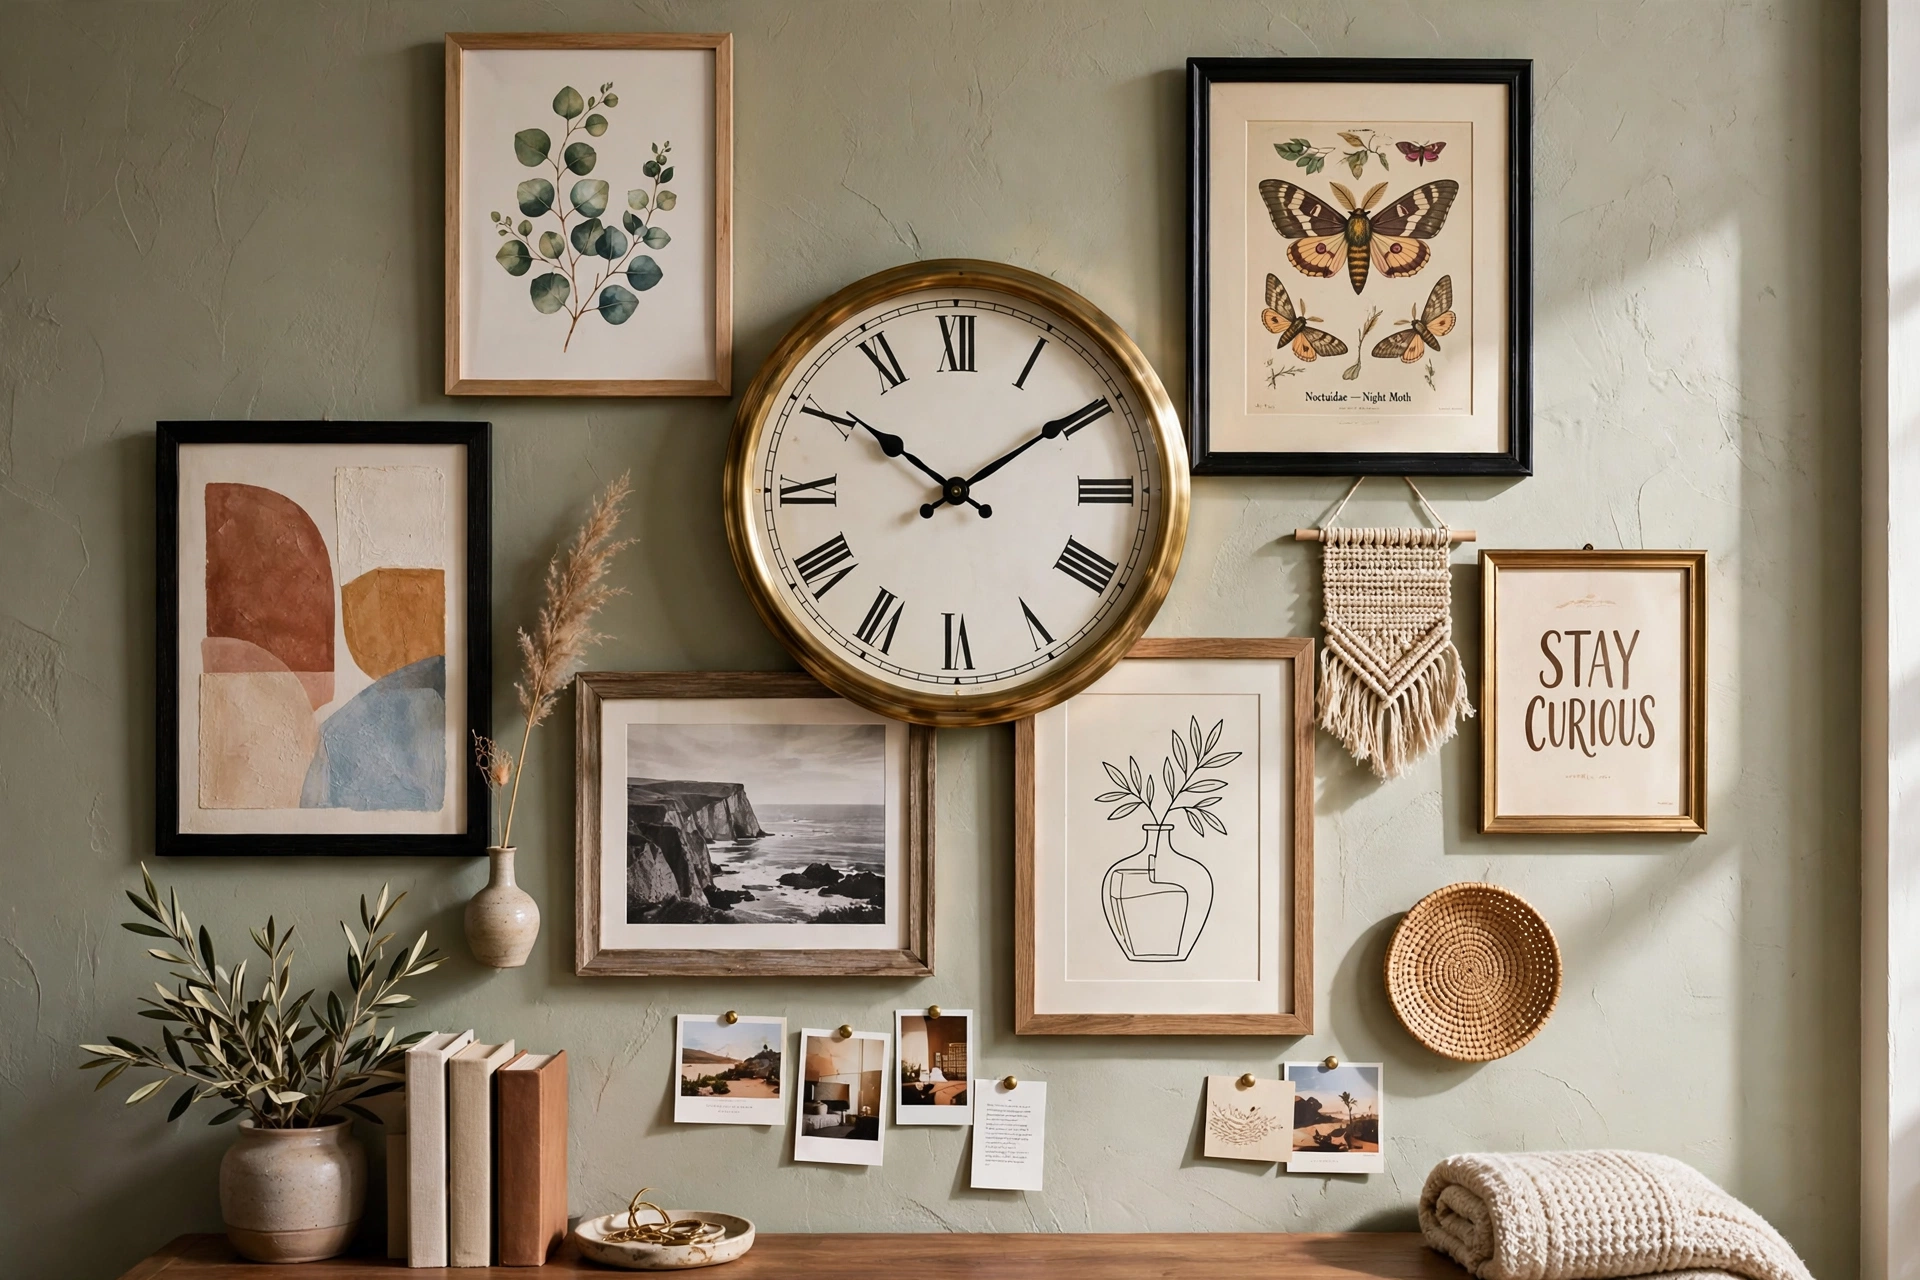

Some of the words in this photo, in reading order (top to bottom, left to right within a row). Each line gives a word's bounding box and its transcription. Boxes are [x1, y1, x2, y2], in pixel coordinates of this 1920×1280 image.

[855, 330, 911, 396] XI
[935, 315, 978, 373] XII
[1011, 335, 1050, 391] I
[798, 393, 857, 442] X
[1304, 390, 1348, 402] Noctuidae
[1362, 391, 1387, 405] Night
[1388, 391, 1412, 402] Moth
[779, 473, 838, 508] IX
[1077, 475, 1134, 508] III
[791, 530, 859, 604] VIII
[1052, 534, 1120, 598] IIII
[852, 585, 906, 657] VII
[940, 612, 976, 670] VI
[1018, 596, 1058, 652] V
[1539, 629, 1641, 690] STAY
[1524, 694, 1656, 758] CURIOUS
